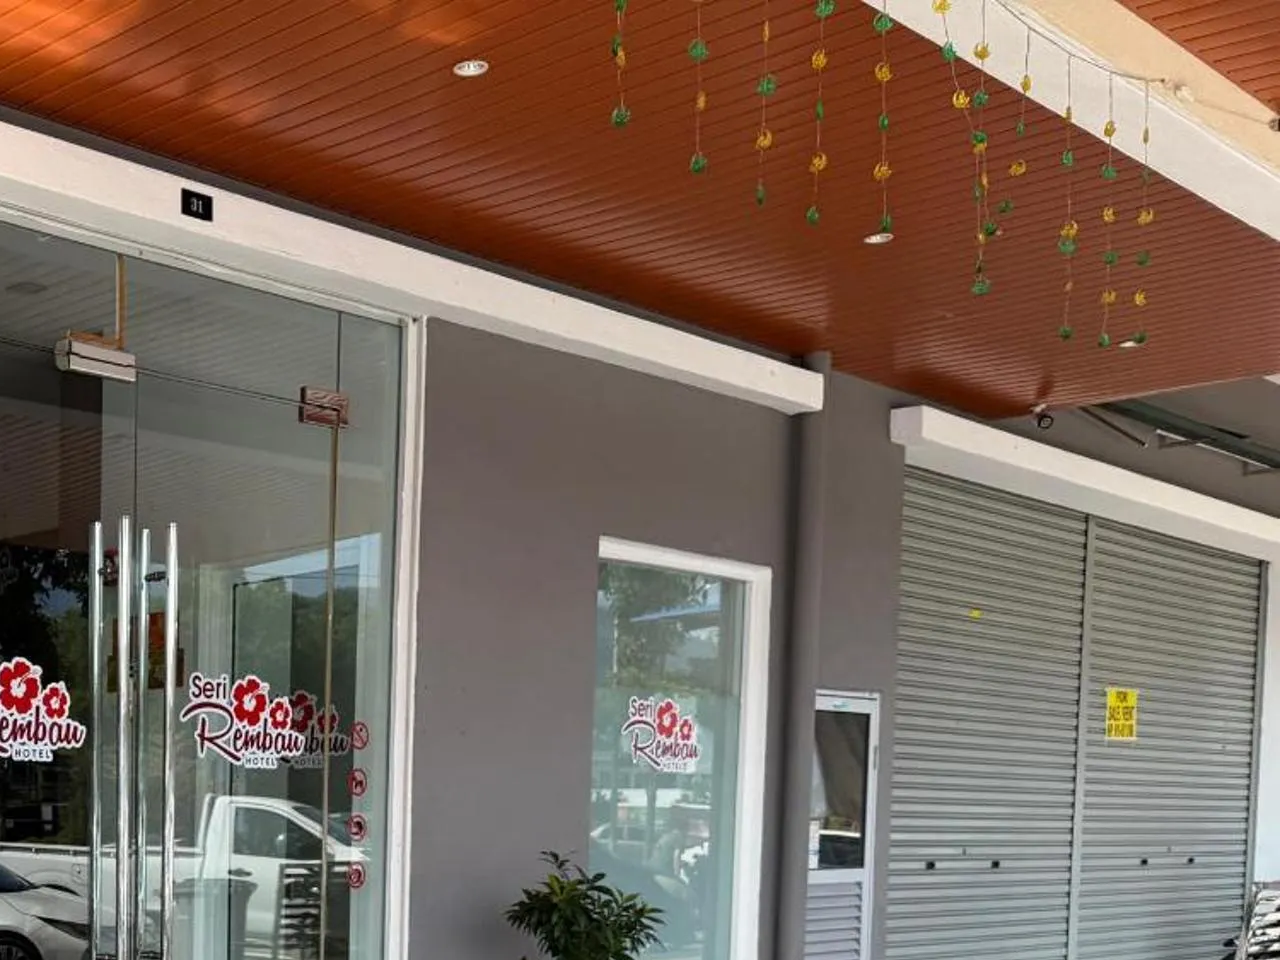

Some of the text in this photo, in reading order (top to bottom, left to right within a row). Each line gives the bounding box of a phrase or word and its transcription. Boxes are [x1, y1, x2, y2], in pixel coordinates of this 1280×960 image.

[190, 197, 204, 214] 31
[191, 674, 227, 700] Seri
[629, 697, 656, 717] Seri
[181, 702, 304, 763] Rembau
[622, 719, 699, 768] Rembau
[14, 748, 51, 760] HOTEL
[244, 756, 277, 768] HOTEL
